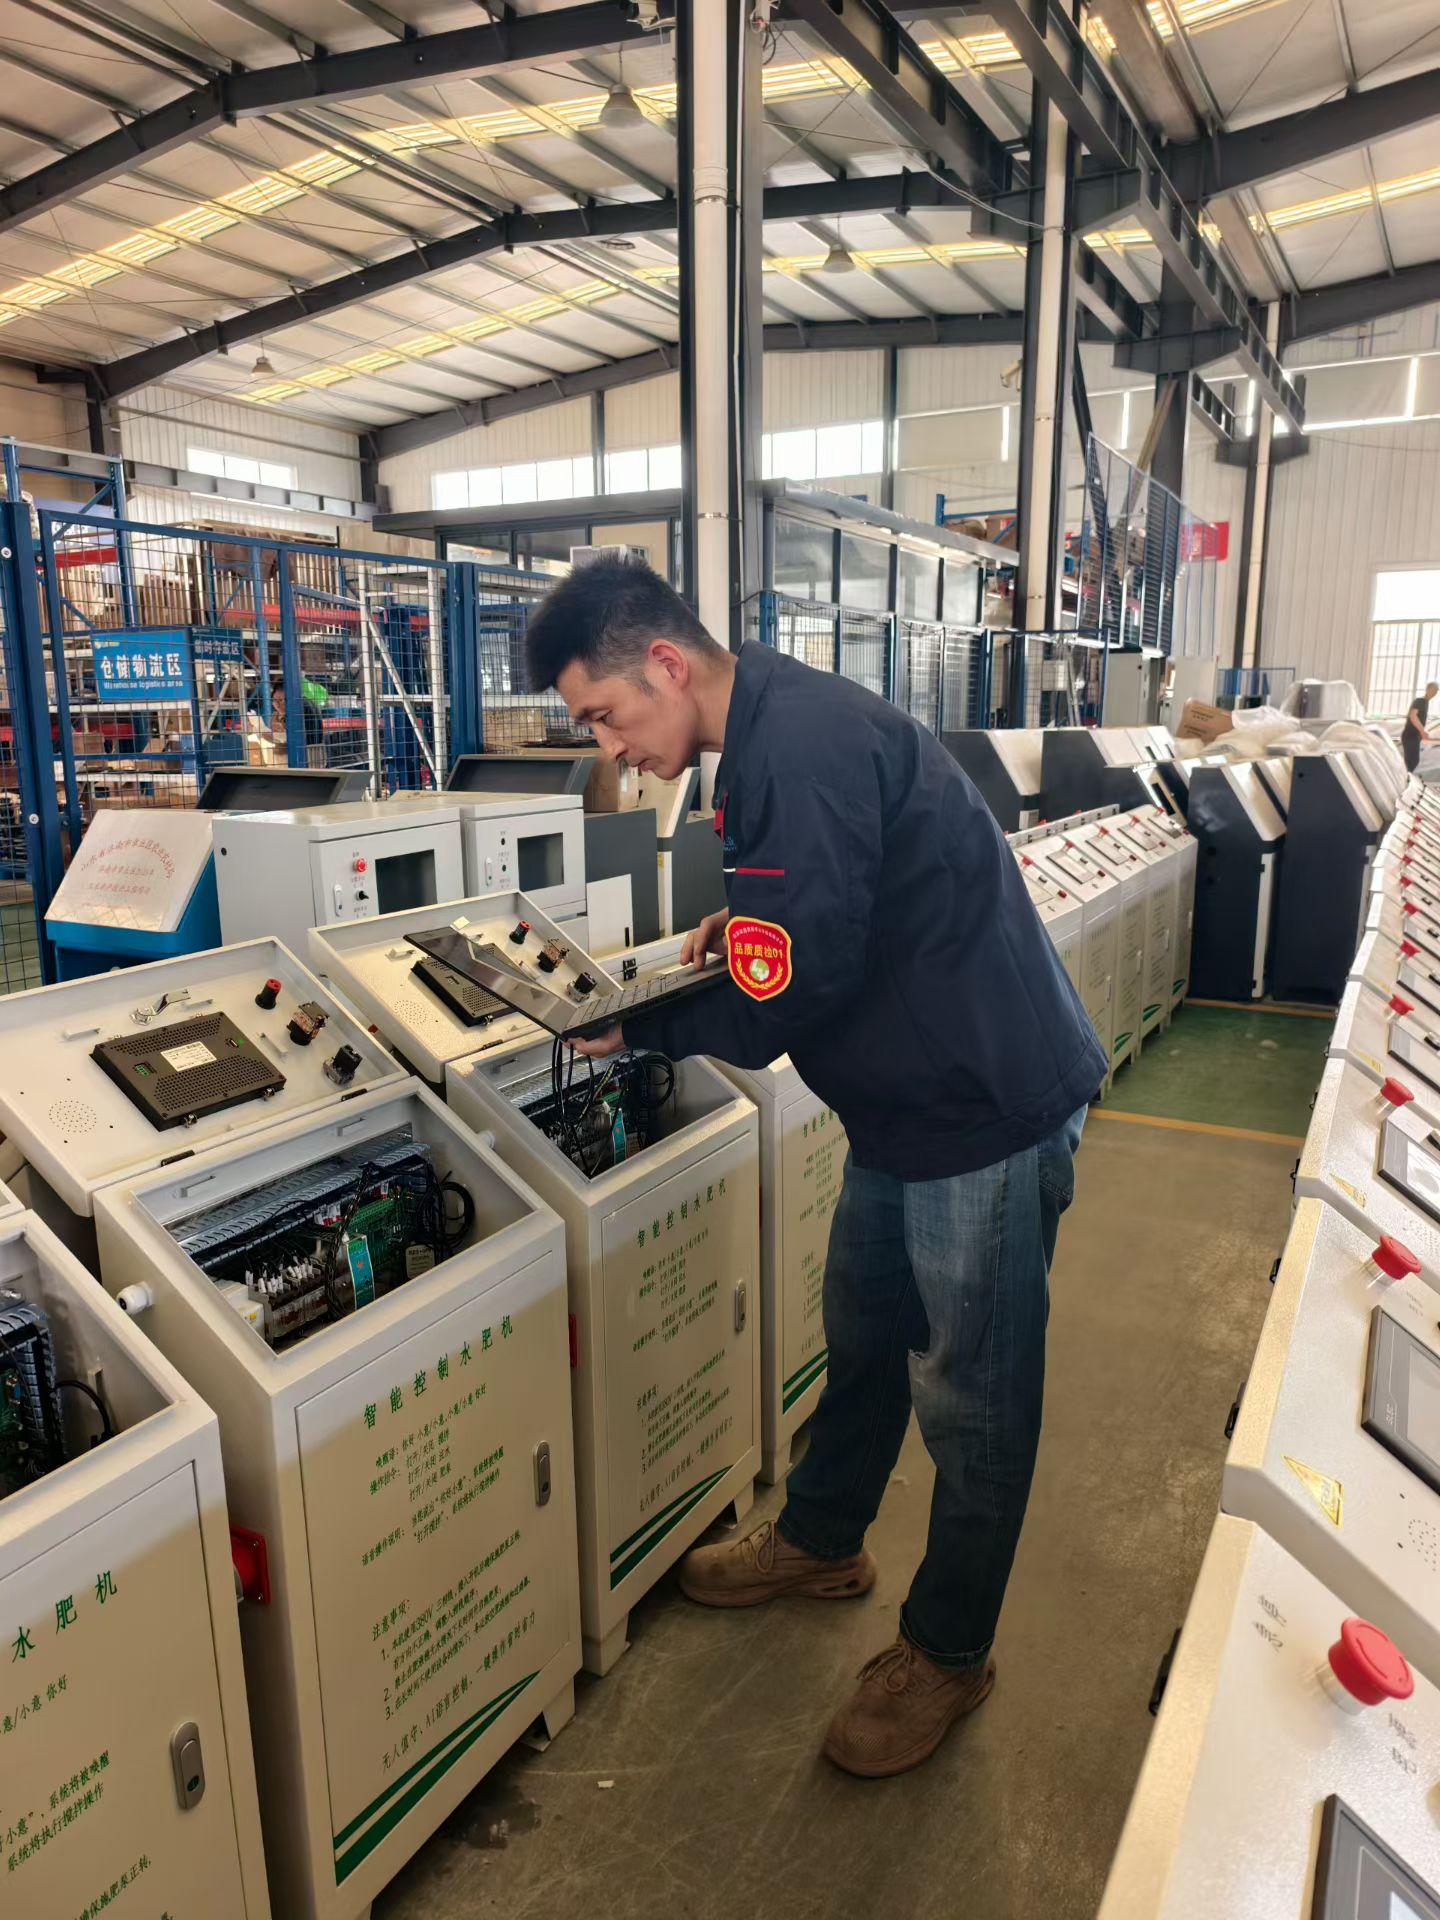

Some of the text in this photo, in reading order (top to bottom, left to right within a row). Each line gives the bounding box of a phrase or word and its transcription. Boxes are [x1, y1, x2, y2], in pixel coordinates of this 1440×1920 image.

[100, 652, 183, 680] 仓储物流区
[734, 942, 784, 959] 品质质检01
[637, 1176, 728, 1248] 智能控制水肥机
[364, 1315, 513, 1430] 智能控制水肥机
[11, 1569, 118, 1663] 水肥机
[0, 1694, 42, 1735] 意/小意
